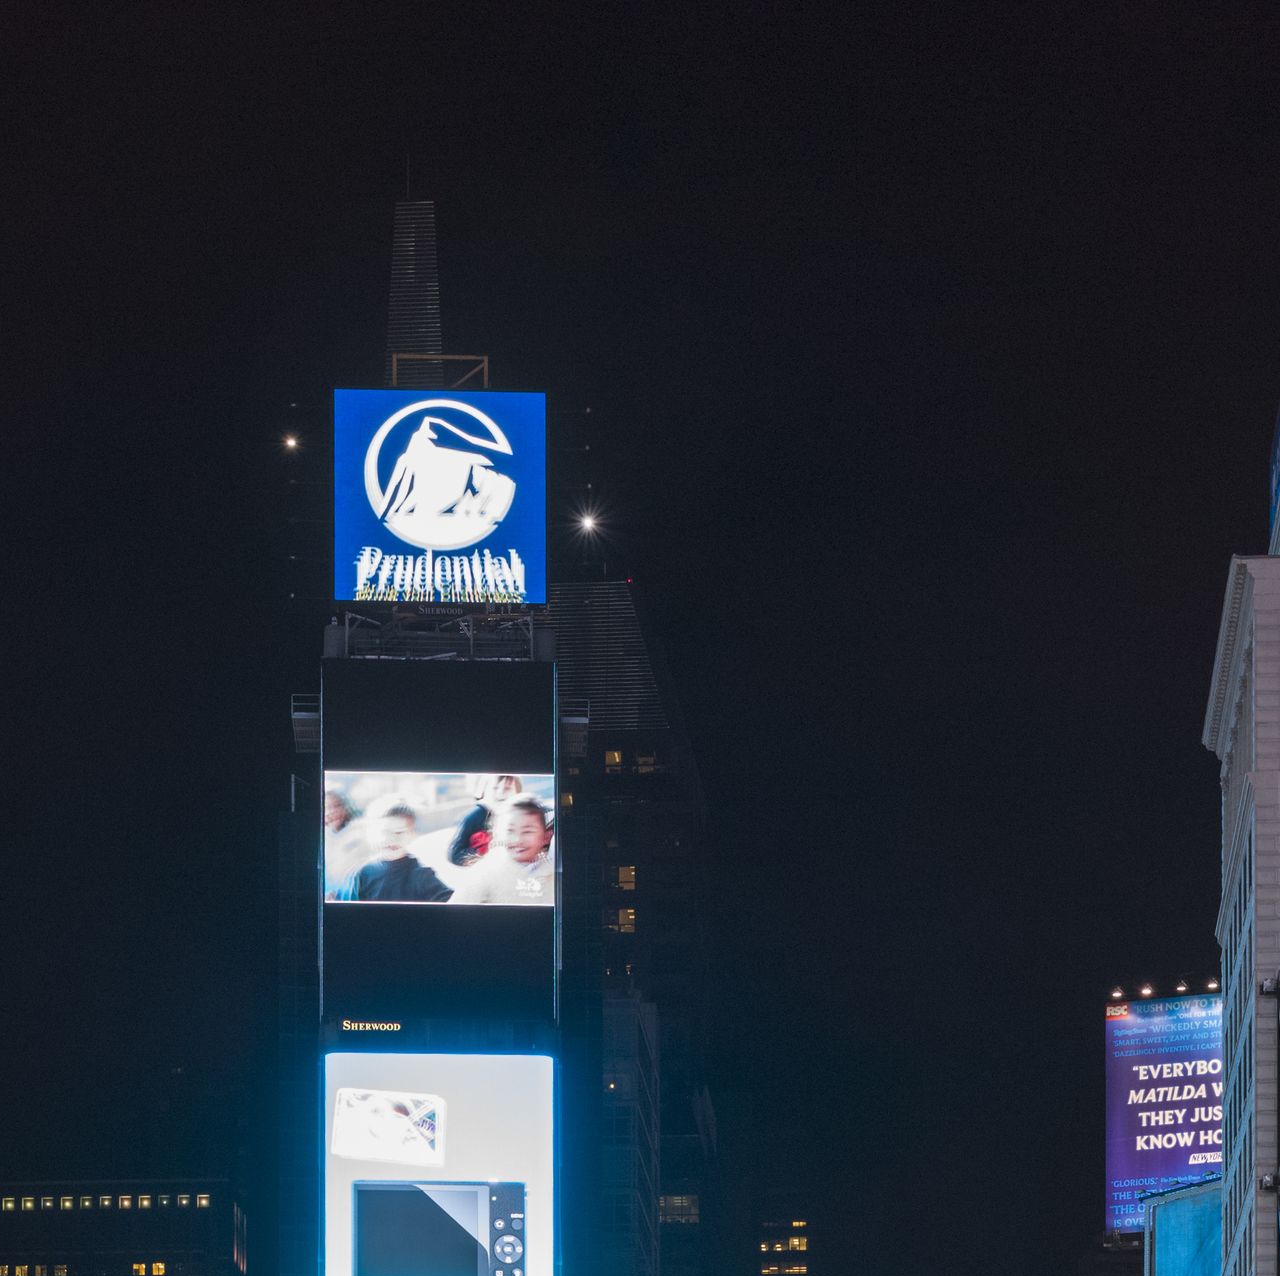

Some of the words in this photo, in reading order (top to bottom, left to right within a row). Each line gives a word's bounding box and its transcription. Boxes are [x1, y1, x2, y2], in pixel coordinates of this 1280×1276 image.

[342, 1020, 401, 1032] SHERWOOD
[1132, 1058, 1222, 1081] “EVERYBO
[1127, 1084, 1207, 1105] MATILDA
[1138, 1108, 1187, 1127] THEY
[1136, 1131, 1196, 1151] KNOW
